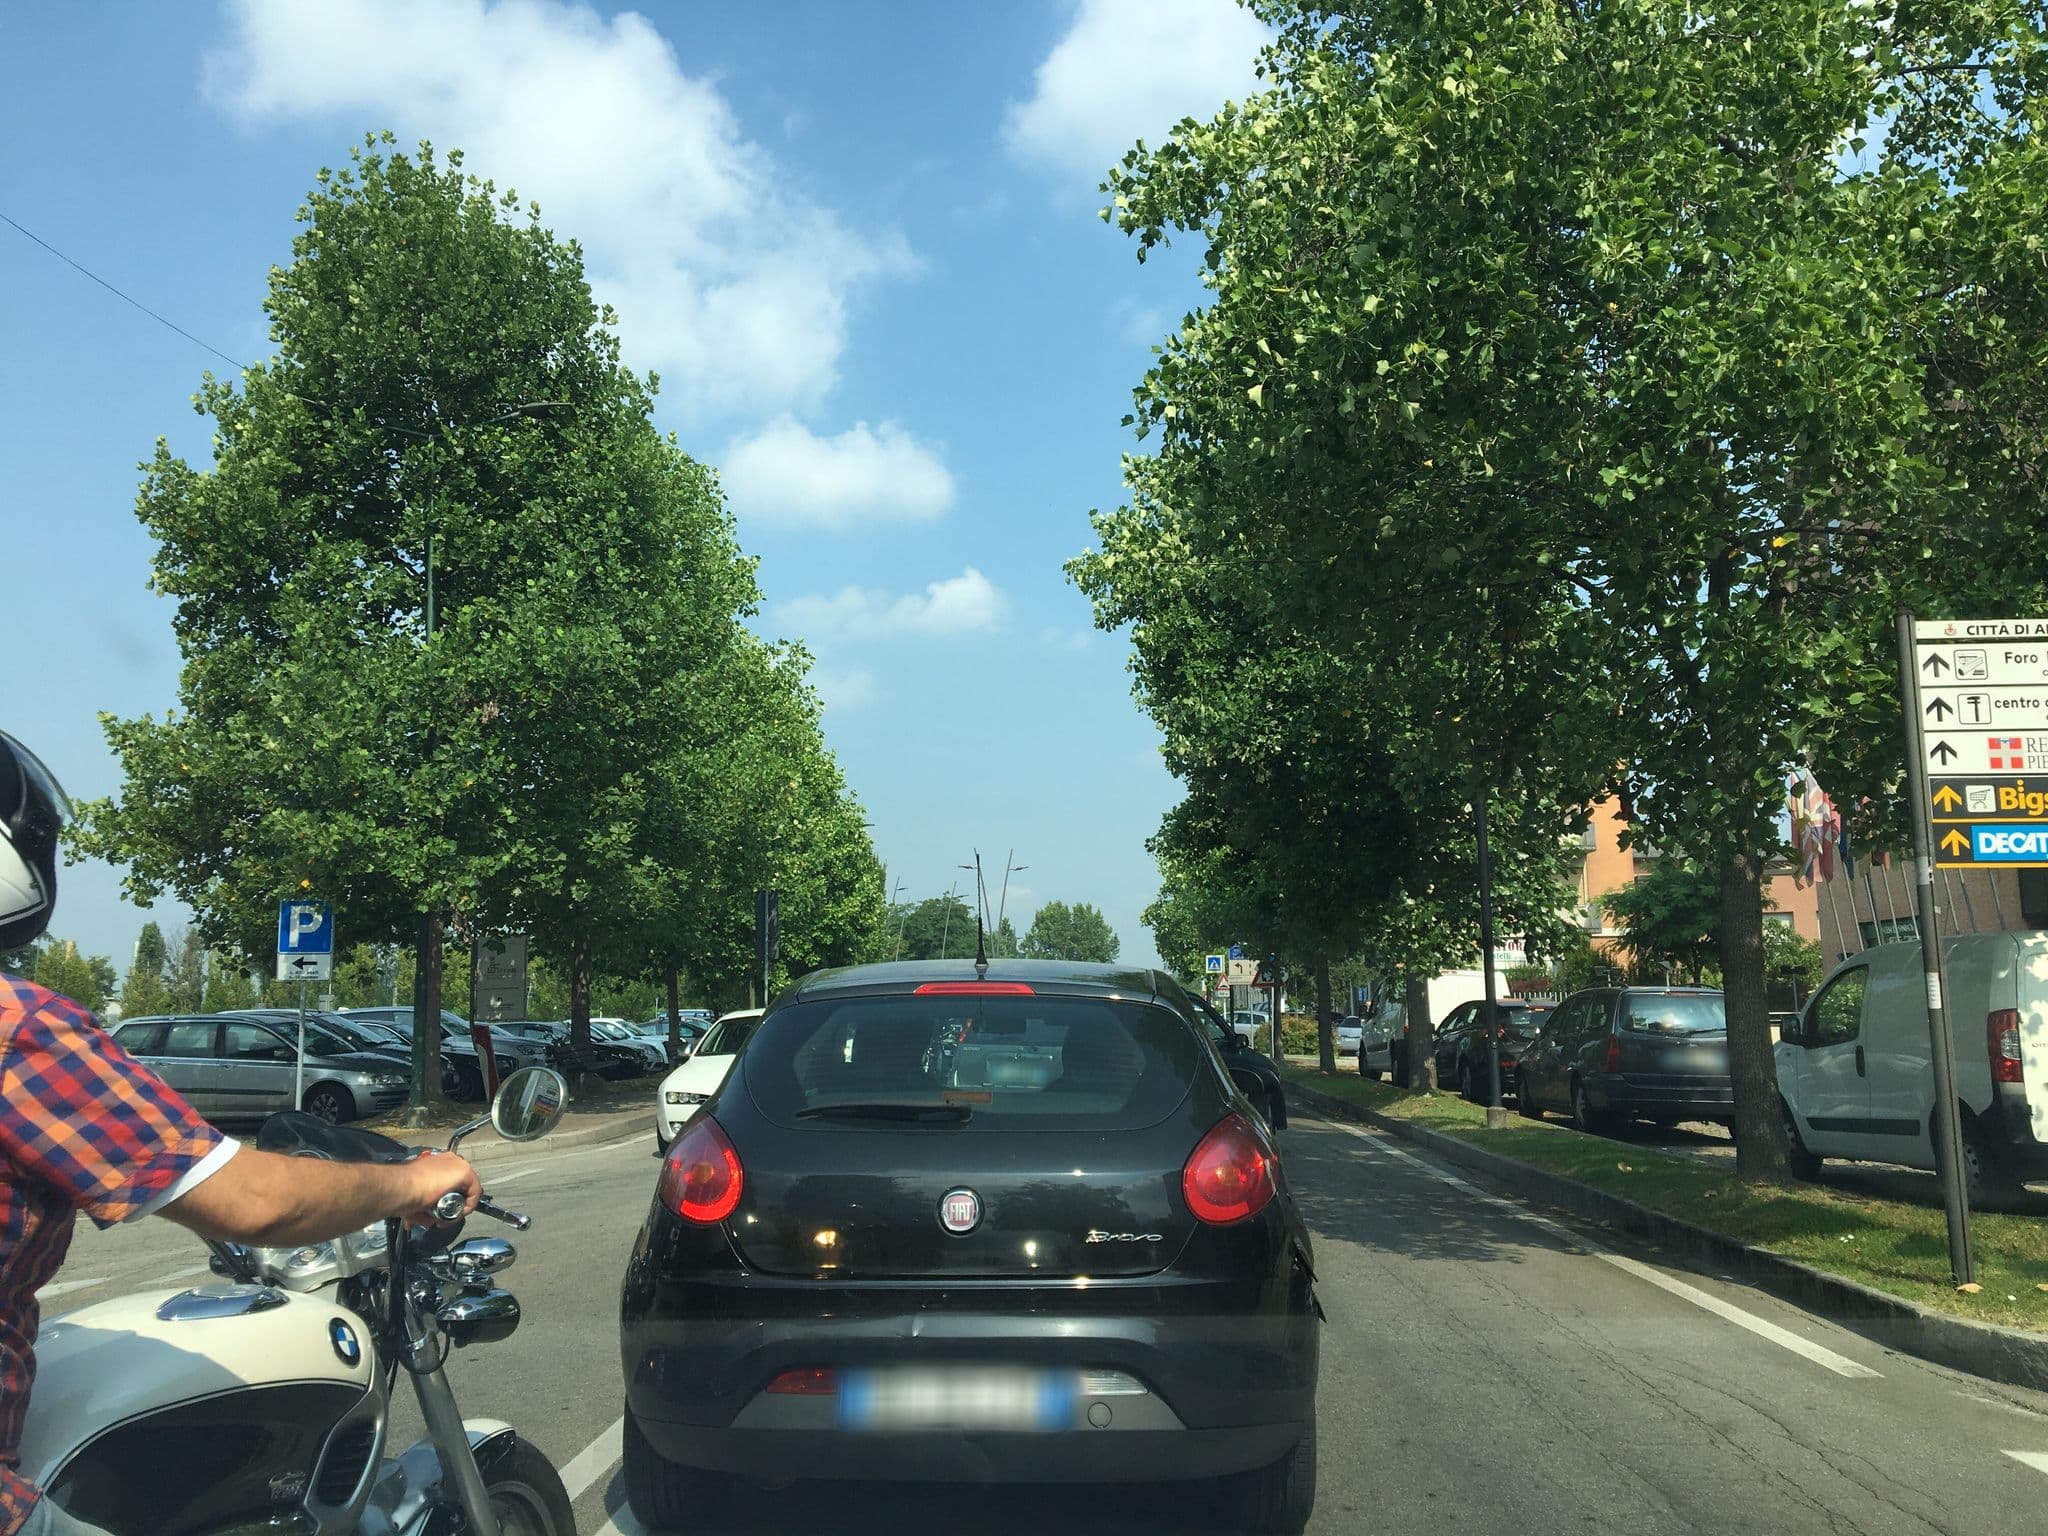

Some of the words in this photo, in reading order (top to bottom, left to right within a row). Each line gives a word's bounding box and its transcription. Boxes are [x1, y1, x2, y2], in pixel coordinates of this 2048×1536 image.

[2014, 624, 2029, 634] DI
[2035, 624, 2048, 634] A
[2004, 652, 2038, 664] Foro
[1994, 697, 2040, 708] centro
[1978, 832, 2048, 854] DECAT
[288, 905, 323, 948] P
[950, 1202, 971, 1221] FIAT
[1085, 1230, 1163, 1243] Bravo
